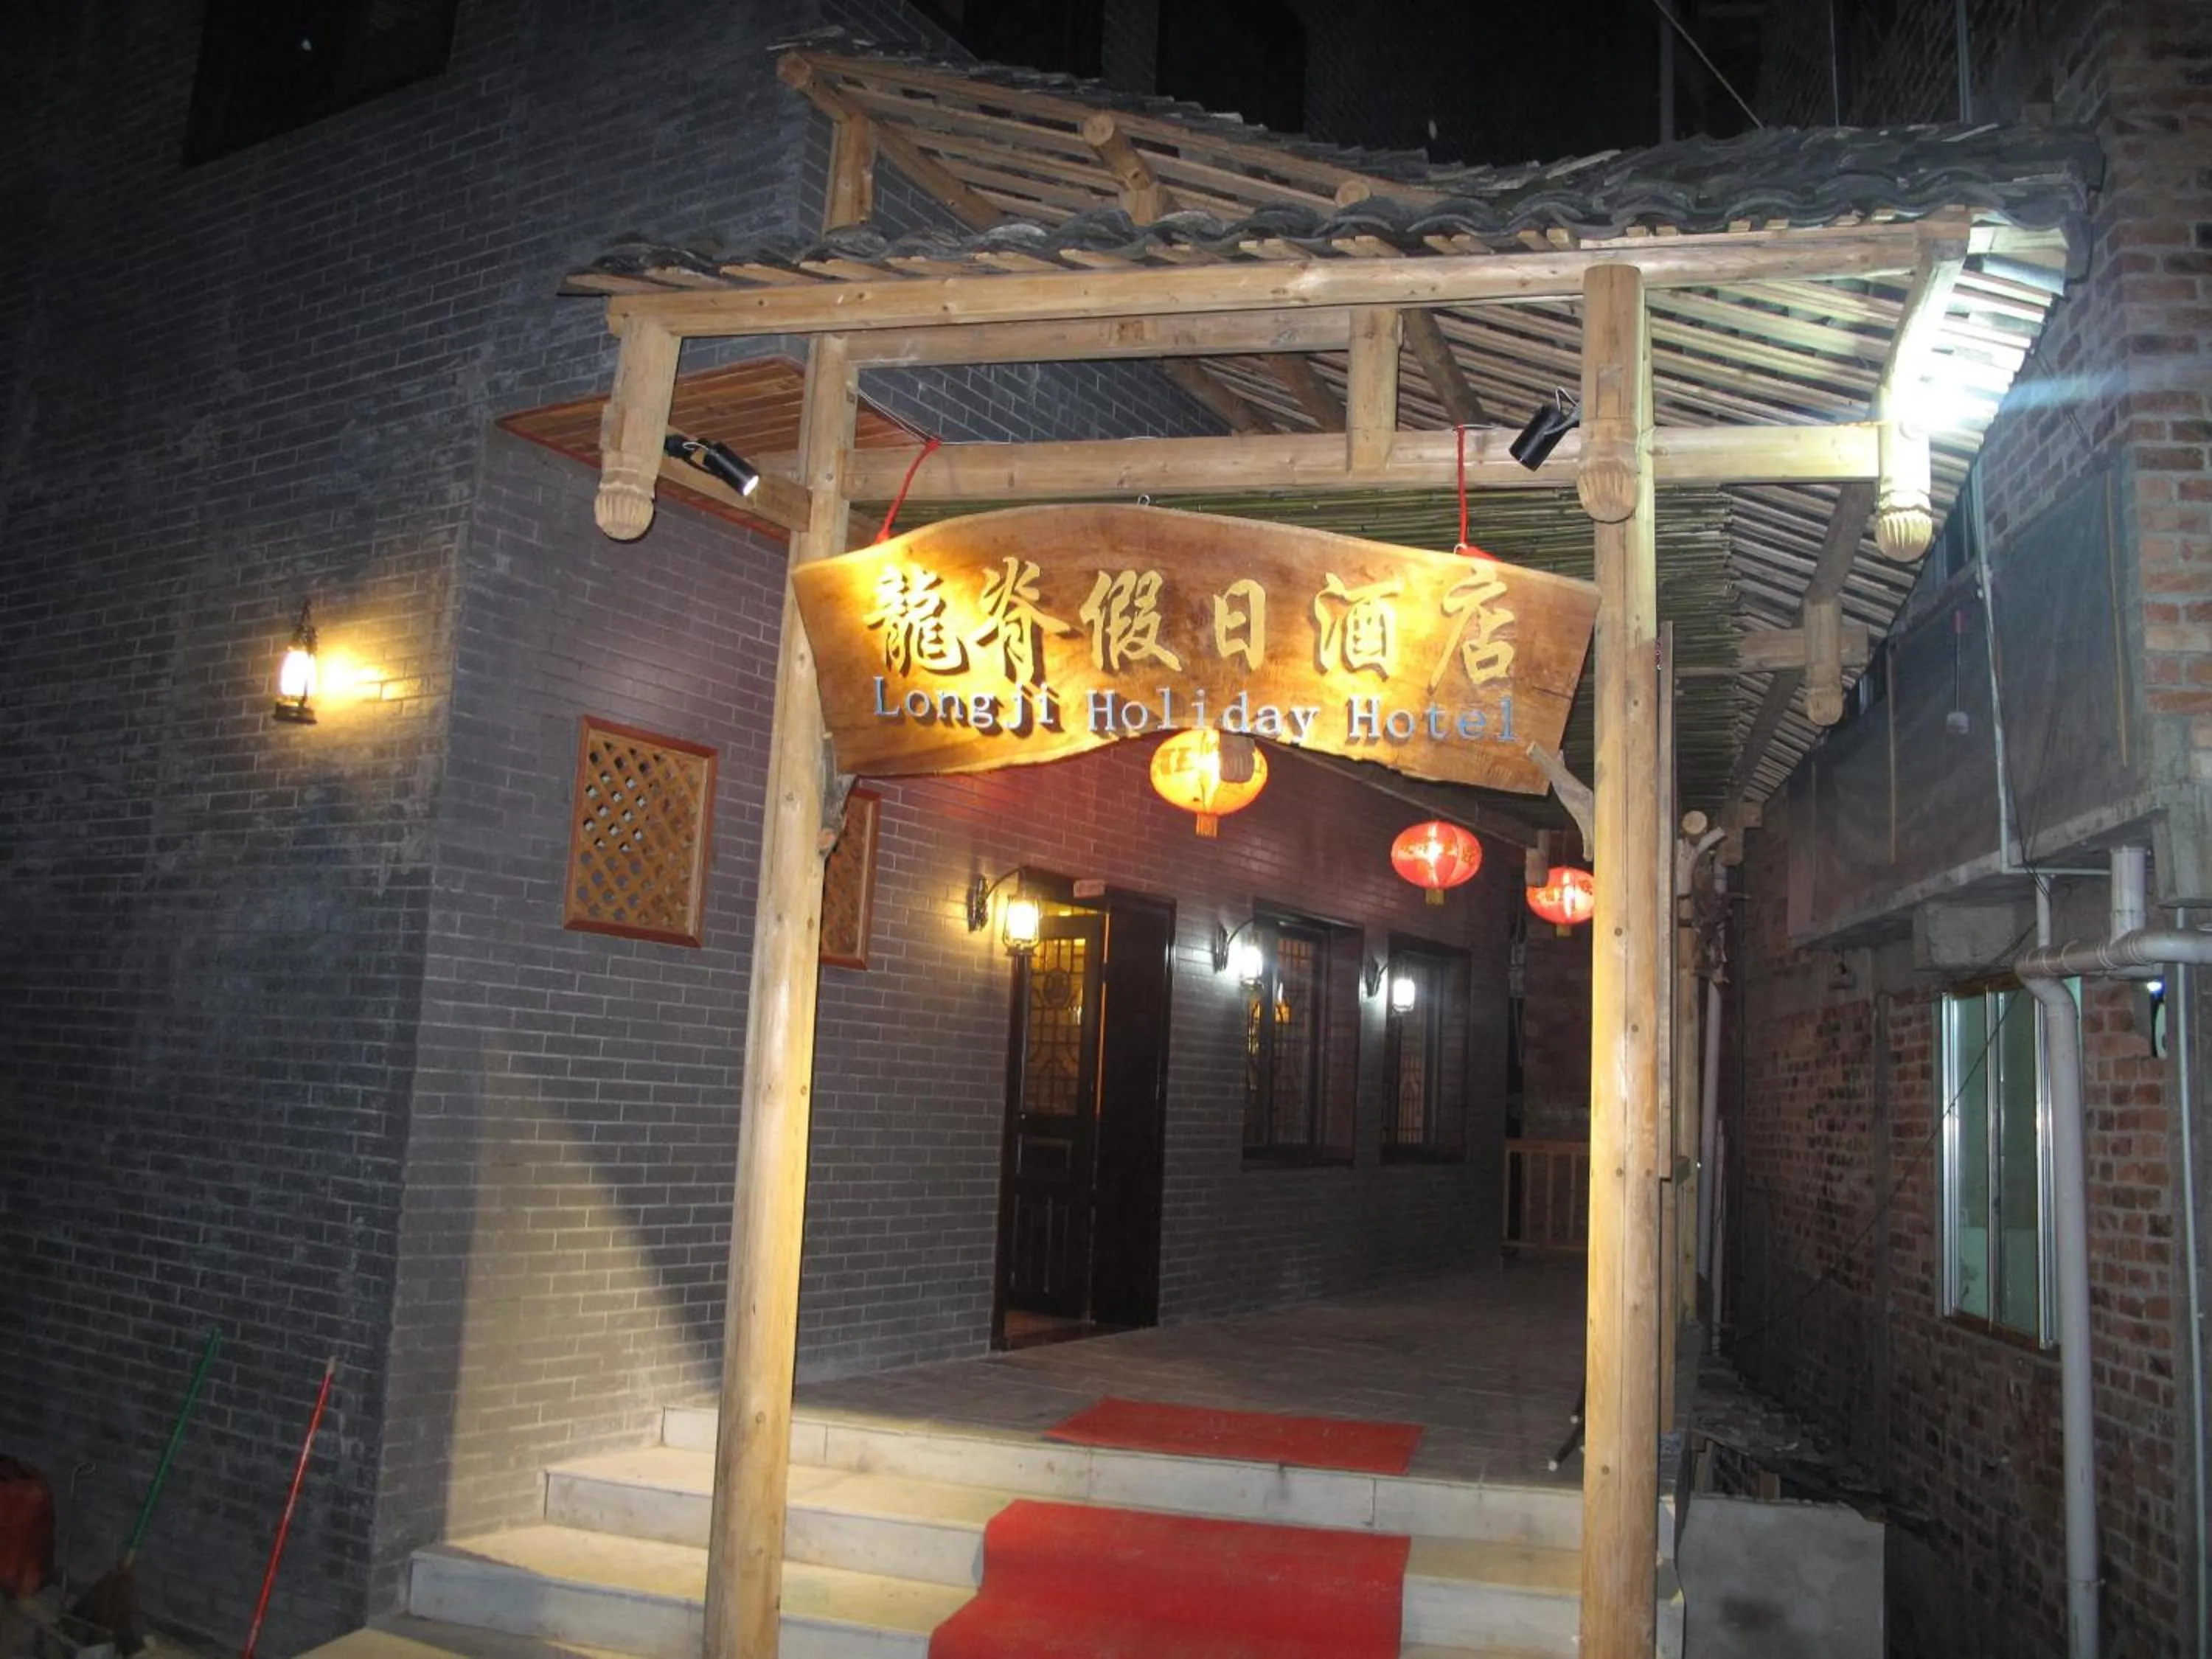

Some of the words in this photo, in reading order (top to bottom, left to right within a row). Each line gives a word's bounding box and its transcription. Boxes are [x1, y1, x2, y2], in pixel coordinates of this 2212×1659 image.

[864, 557, 1515, 694] 龍脊假日酒店
[872, 676, 1054, 730] Longji
[1087, 686, 1322, 745] Holiday
[1348, 695, 1519, 742] Hotel
